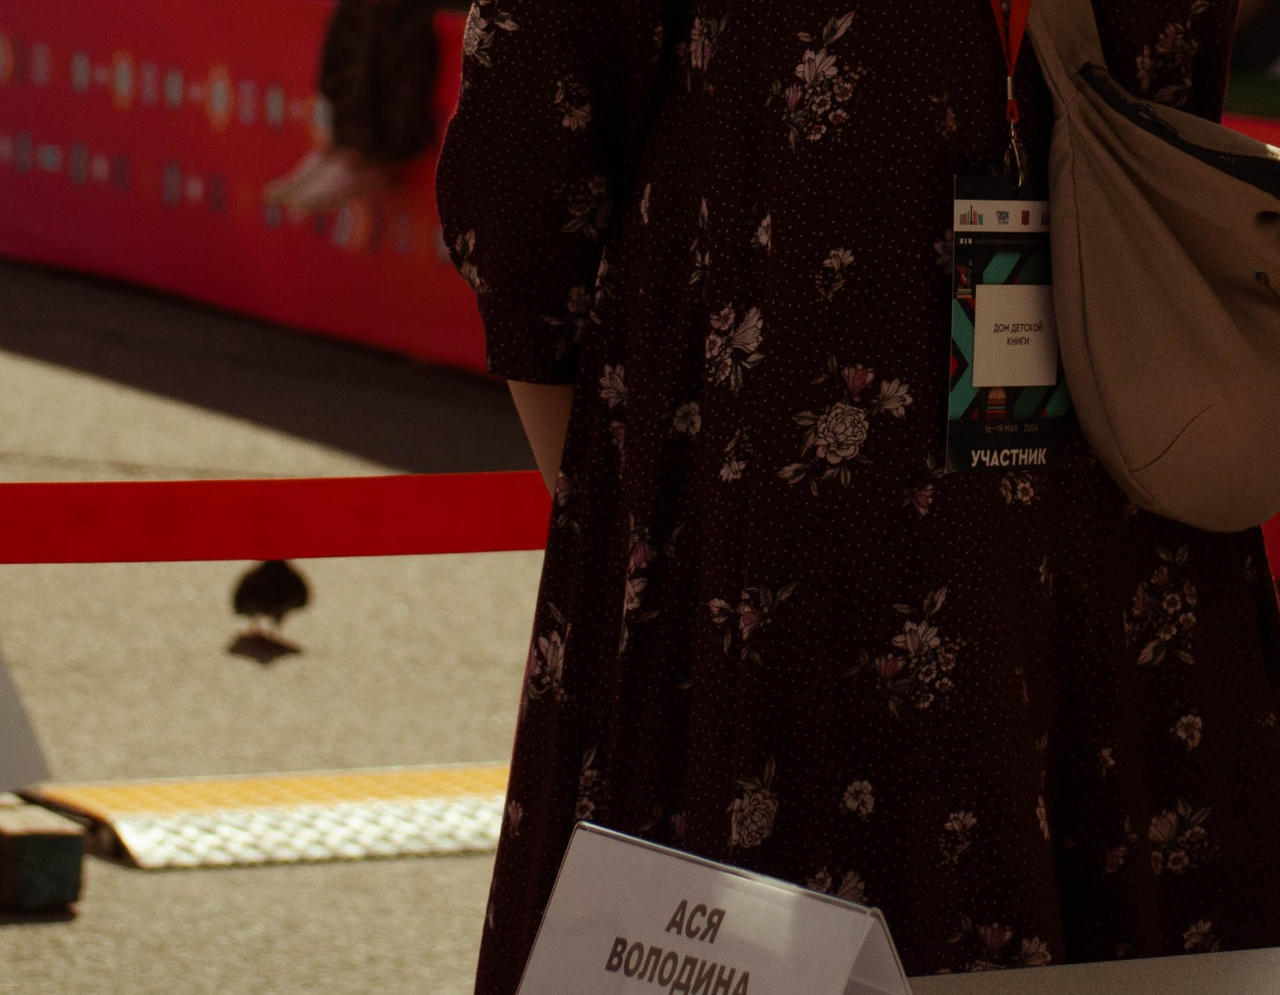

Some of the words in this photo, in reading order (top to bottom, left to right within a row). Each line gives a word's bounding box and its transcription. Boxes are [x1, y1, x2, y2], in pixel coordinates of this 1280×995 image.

[993, 323, 1010, 333] ДОМ
[1010, 320, 1043, 333] ДЕТСКОЙ
[1006, 337, 1030, 345] КНИГИ
[1024, 423, 1039, 433] 2024
[971, 448, 1047, 467] УЧАСТНИК
[664, 899, 726, 944] АСЯ
[605, 936, 750, 995] ВОЛОДИНА
